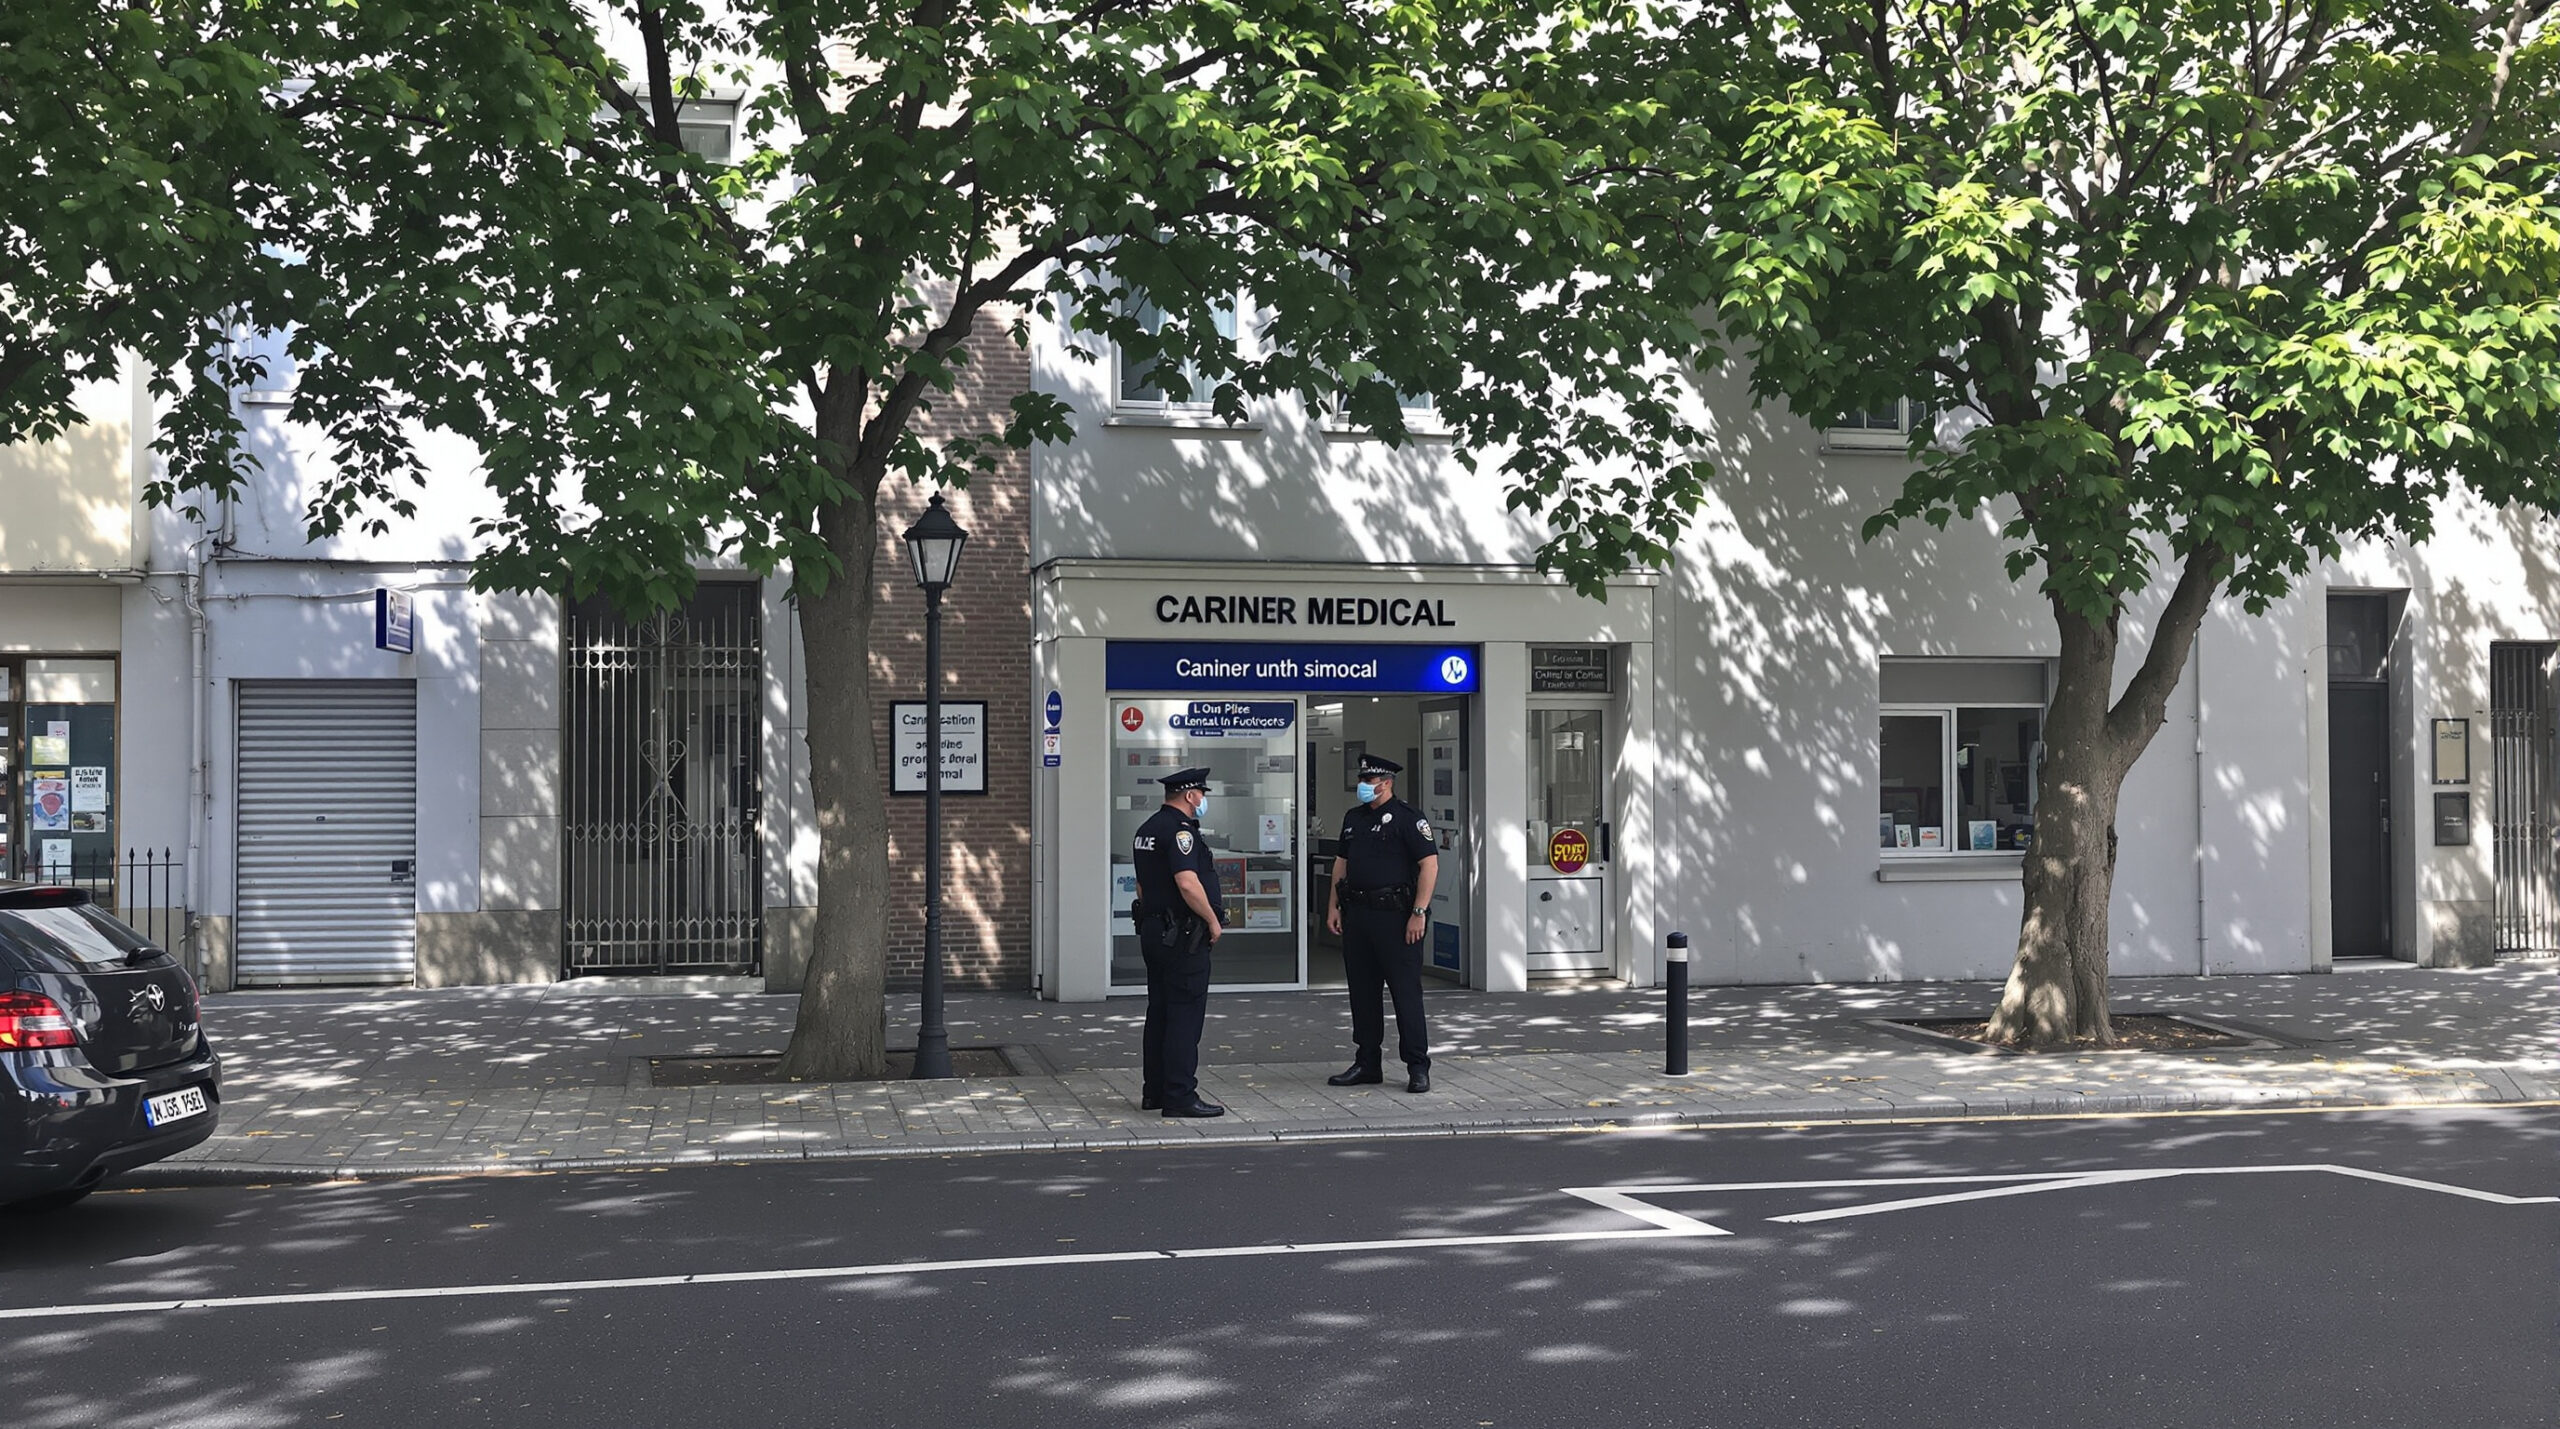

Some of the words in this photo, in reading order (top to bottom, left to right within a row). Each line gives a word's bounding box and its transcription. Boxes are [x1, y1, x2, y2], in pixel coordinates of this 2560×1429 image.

[1156, 595, 1297, 625] CARINER
[1307, 597, 1456, 627] MEDICAL
[1176, 659, 1250, 678] Caniner
[1256, 660, 1298, 678] unth
[1304, 660, 1377, 679] simocal
